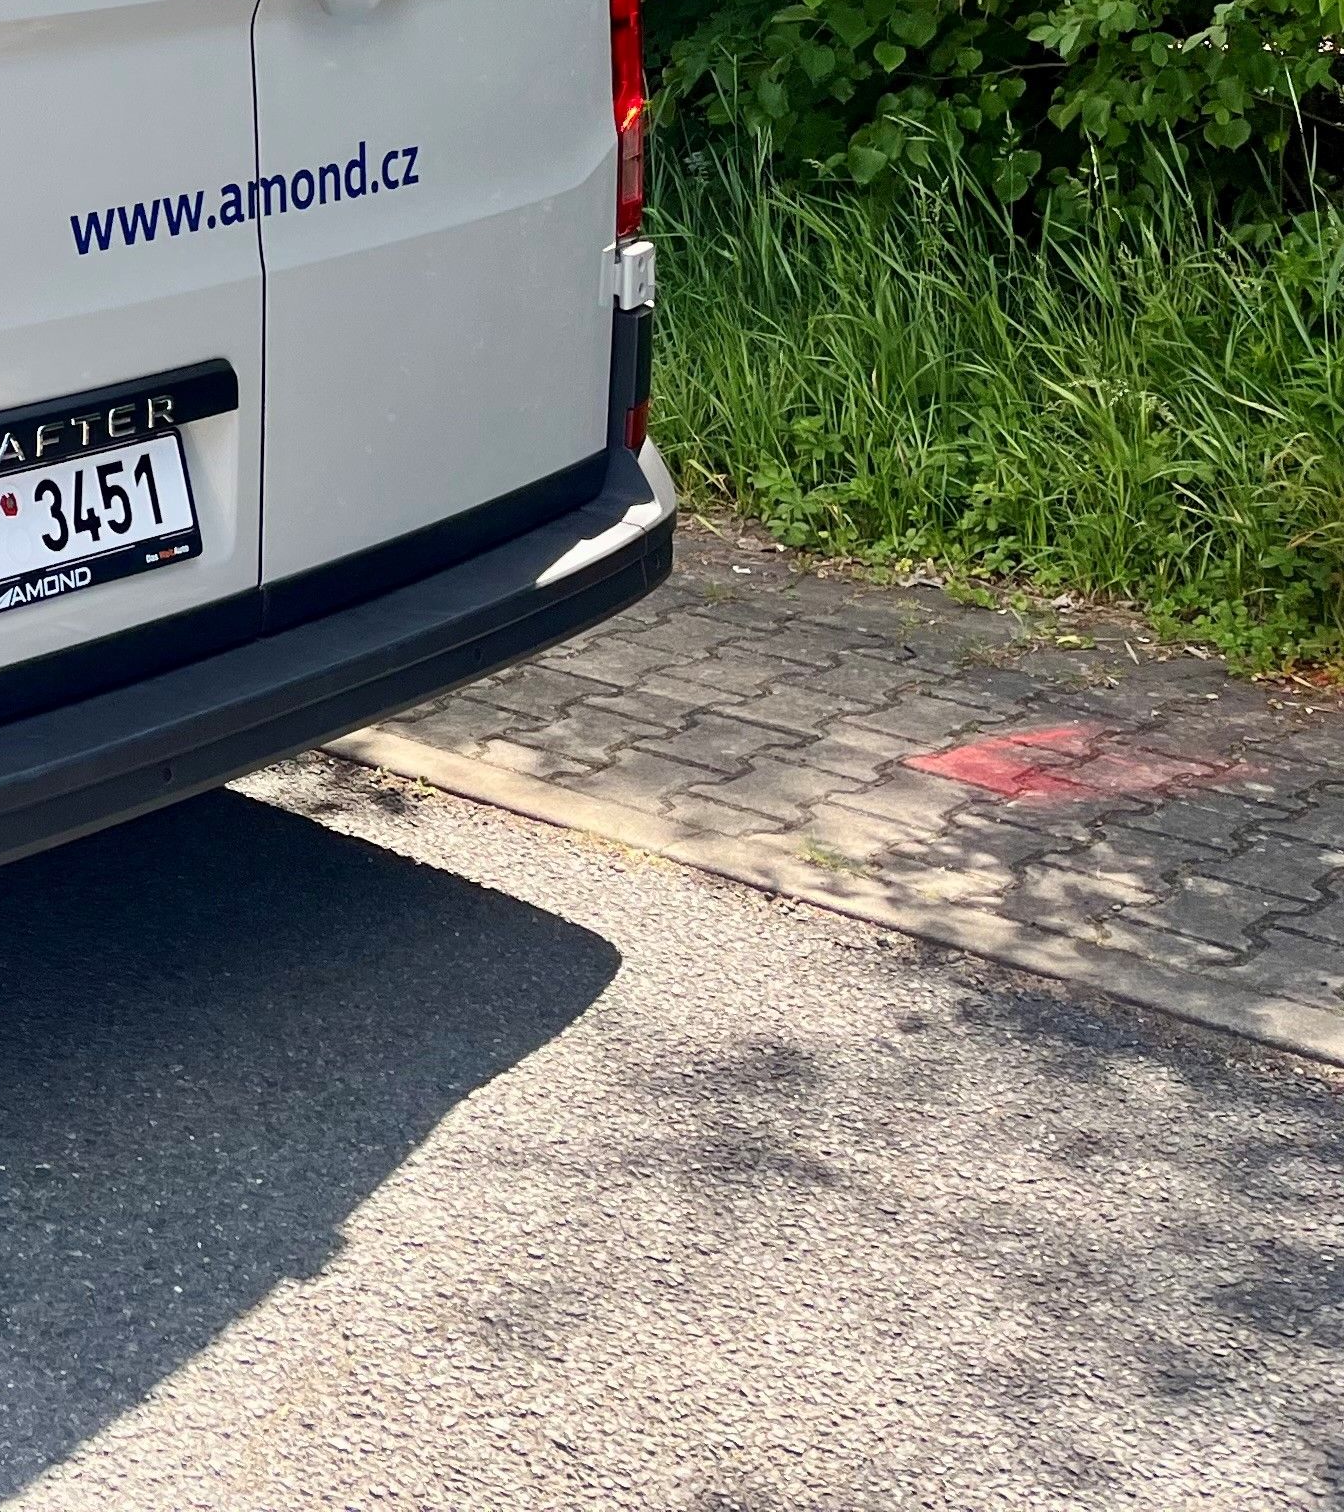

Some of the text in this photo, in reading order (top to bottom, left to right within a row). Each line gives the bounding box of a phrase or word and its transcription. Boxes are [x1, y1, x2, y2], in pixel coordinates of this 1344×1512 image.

[70, 141, 420, 255] www.amond.cz
[34, 453, 163, 553] 3451
[10, 567, 91, 607] AMOND
